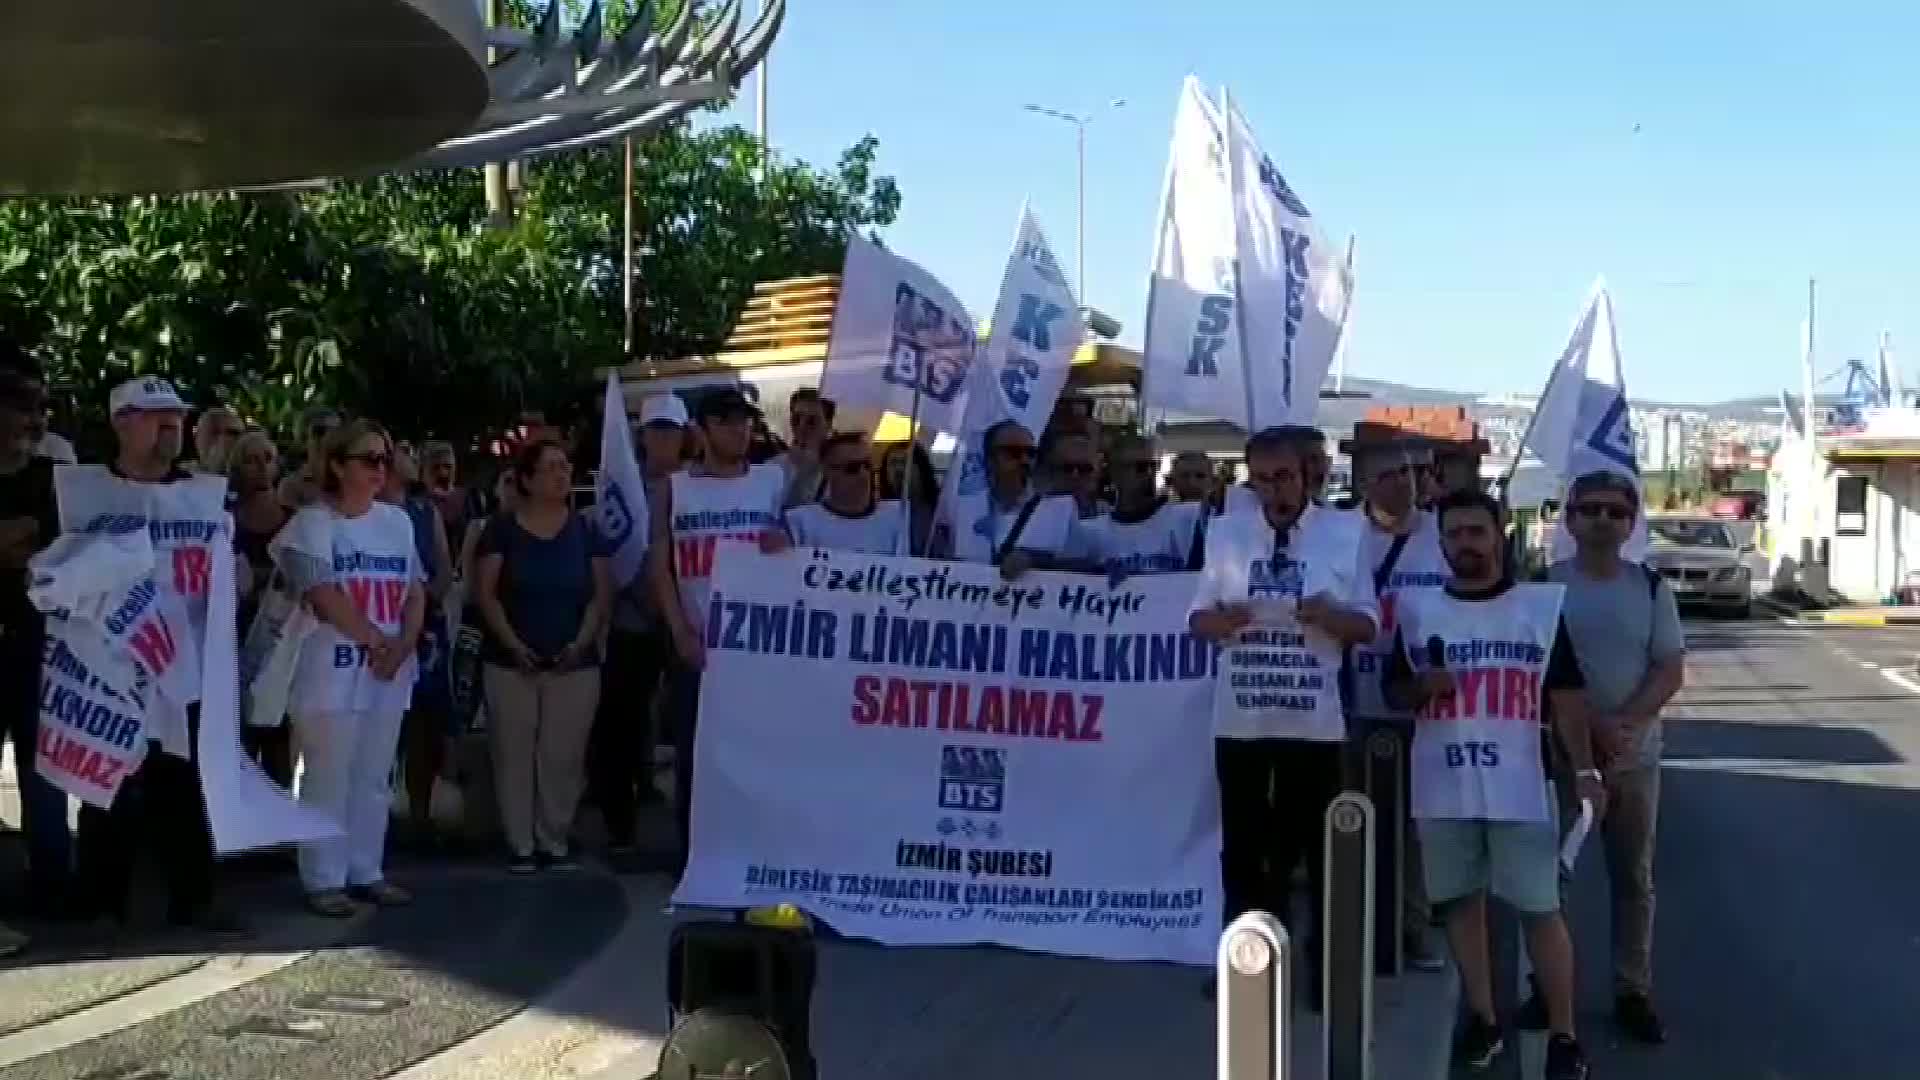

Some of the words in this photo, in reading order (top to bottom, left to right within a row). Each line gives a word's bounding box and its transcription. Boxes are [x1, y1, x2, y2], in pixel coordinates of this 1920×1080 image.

[803, 549, 1044, 619] Özelleştirmeye
[707, 591, 838, 658] İZMİR
[849, 605, 1008, 673] LİMANI
[850, 674, 1104, 742] SATILAMAZ
[1416, 667, 1541, 721] AYIR!
[1446, 742, 1499, 768] BTS
[896, 839, 962, 873] İZMİR
[967, 847, 1052, 879] ŞUBESİ
